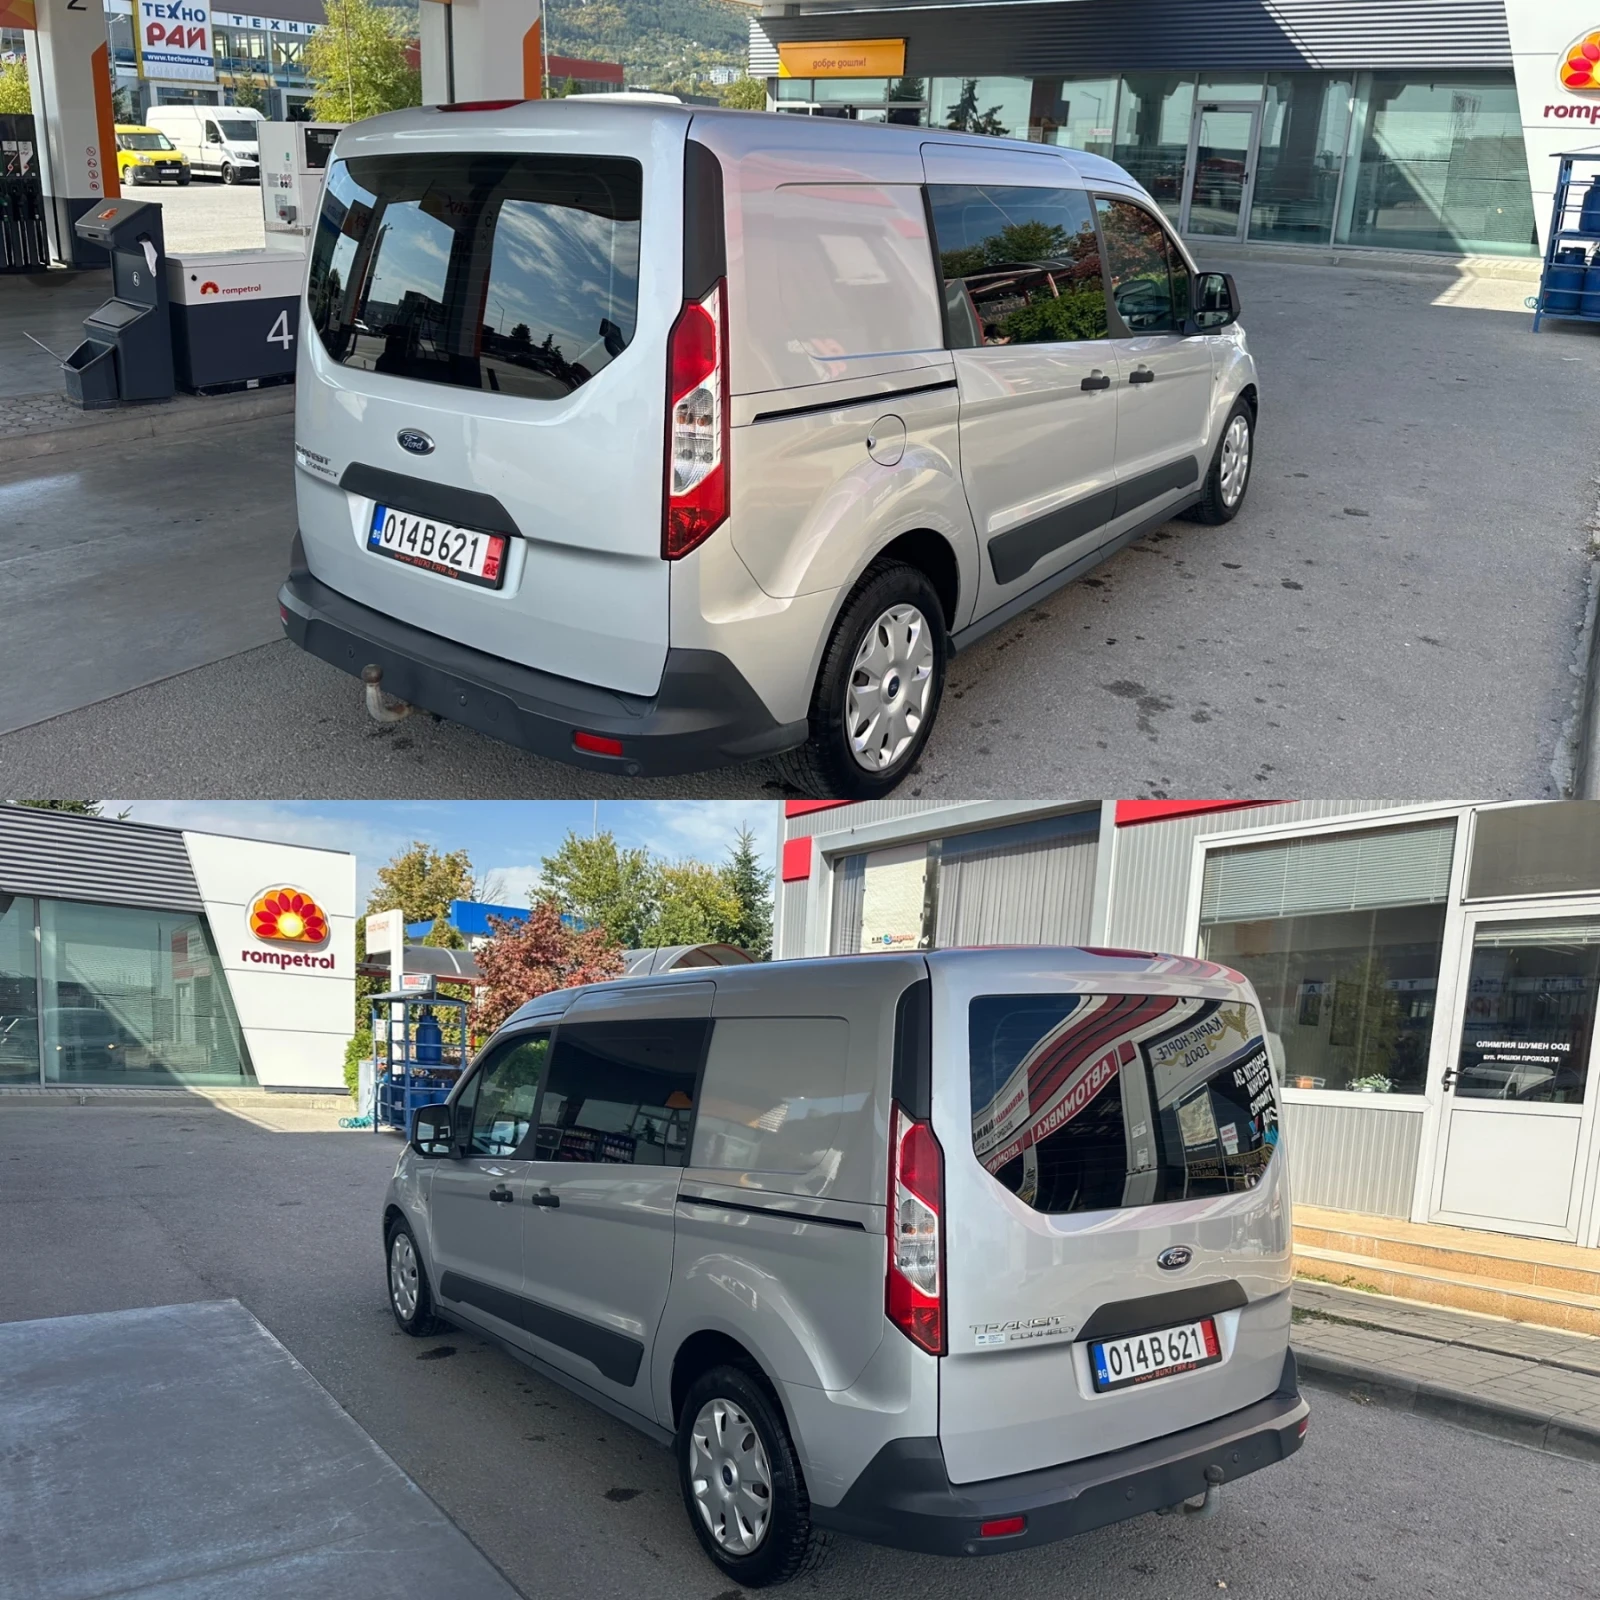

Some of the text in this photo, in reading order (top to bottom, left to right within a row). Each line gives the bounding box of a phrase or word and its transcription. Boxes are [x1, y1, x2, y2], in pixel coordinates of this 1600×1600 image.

[142, 0, 206, 22] ТЕХНО
[146, 22, 206, 51] РАЙ
[147, 53, 209, 66] www.technorai.bg
[812, 57, 867, 70] добре дошли!
[222, 283, 262, 296] rompetrol
[266, 309, 294, 350] 4
[402, 433, 425, 451] Ford
[384, 513, 479, 569] 014B621
[241, 949, 335, 970] rompetrol
[1476, 1041, 1571, 1051] ОЛИМПИЯ ШУМЕН ООД
[1167, 1252, 1187, 1266] Ford
[969, 1315, 1067, 1335] TRANSIT
[1109, 1327, 1201, 1376] 014B621
